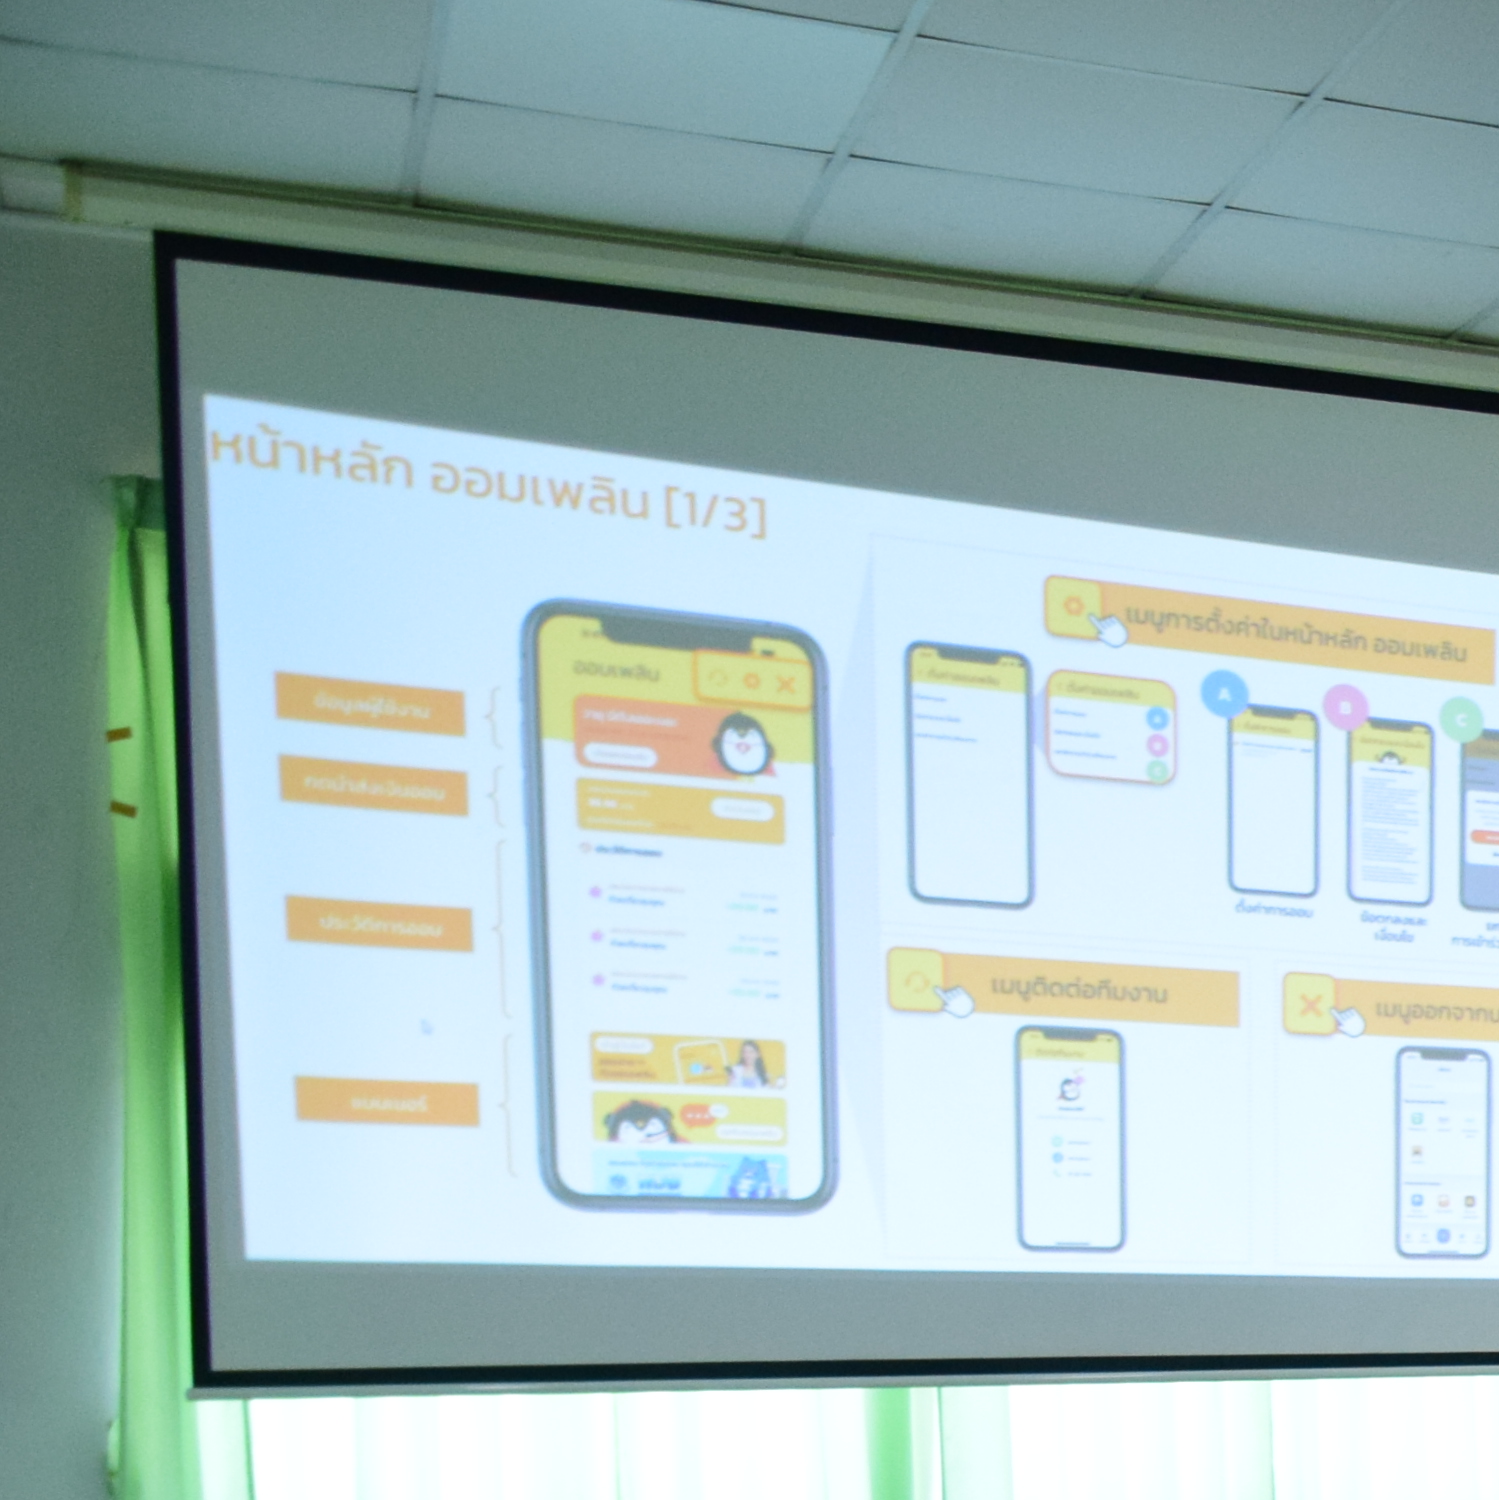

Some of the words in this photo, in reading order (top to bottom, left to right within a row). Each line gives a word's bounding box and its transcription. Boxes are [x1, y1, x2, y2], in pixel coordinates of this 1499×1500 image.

[209, 422, 413, 490] หน้าหลัก
[430, 458, 650, 521] ออมเพลิน
[664, 486, 768, 542] [1/3]
[1372, 638, 1468, 663] ออมเพลิน
[1218, 688, 1231, 701] A
[1339, 702, 1352, 714] B
[1455, 713, 1467, 727] C
[990, 976, 1168, 1003] เมนูติดต่อทีมงาน
